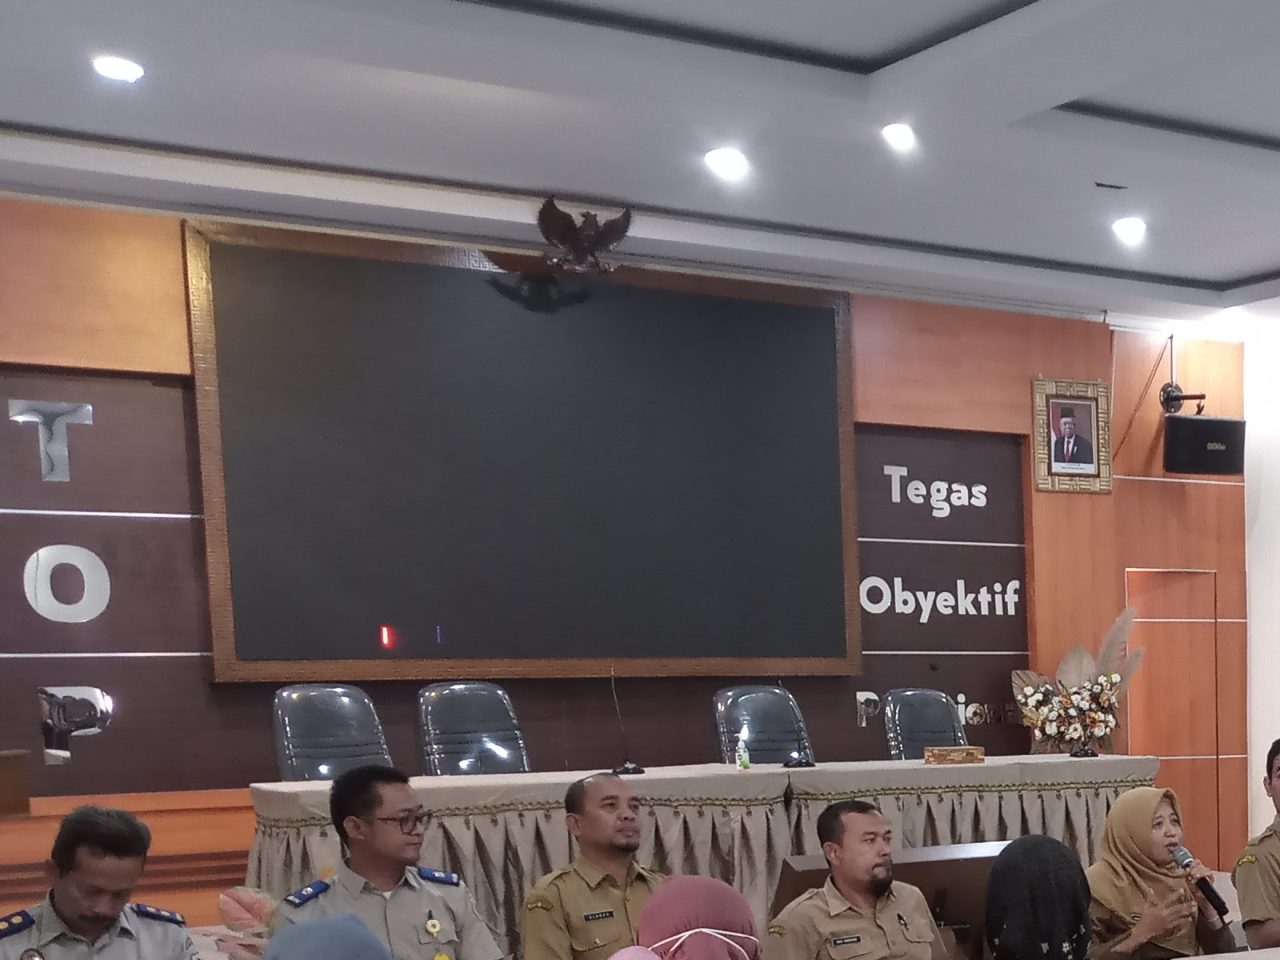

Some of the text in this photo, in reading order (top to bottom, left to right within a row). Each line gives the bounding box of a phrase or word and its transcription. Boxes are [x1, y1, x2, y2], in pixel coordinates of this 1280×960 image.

[8, 399, 94, 482] T
[883, 464, 988, 518] Tegas
[23, 543, 112, 623] O
[858, 575, 1021, 624] Obyektif
[38, 685, 116, 766] P
